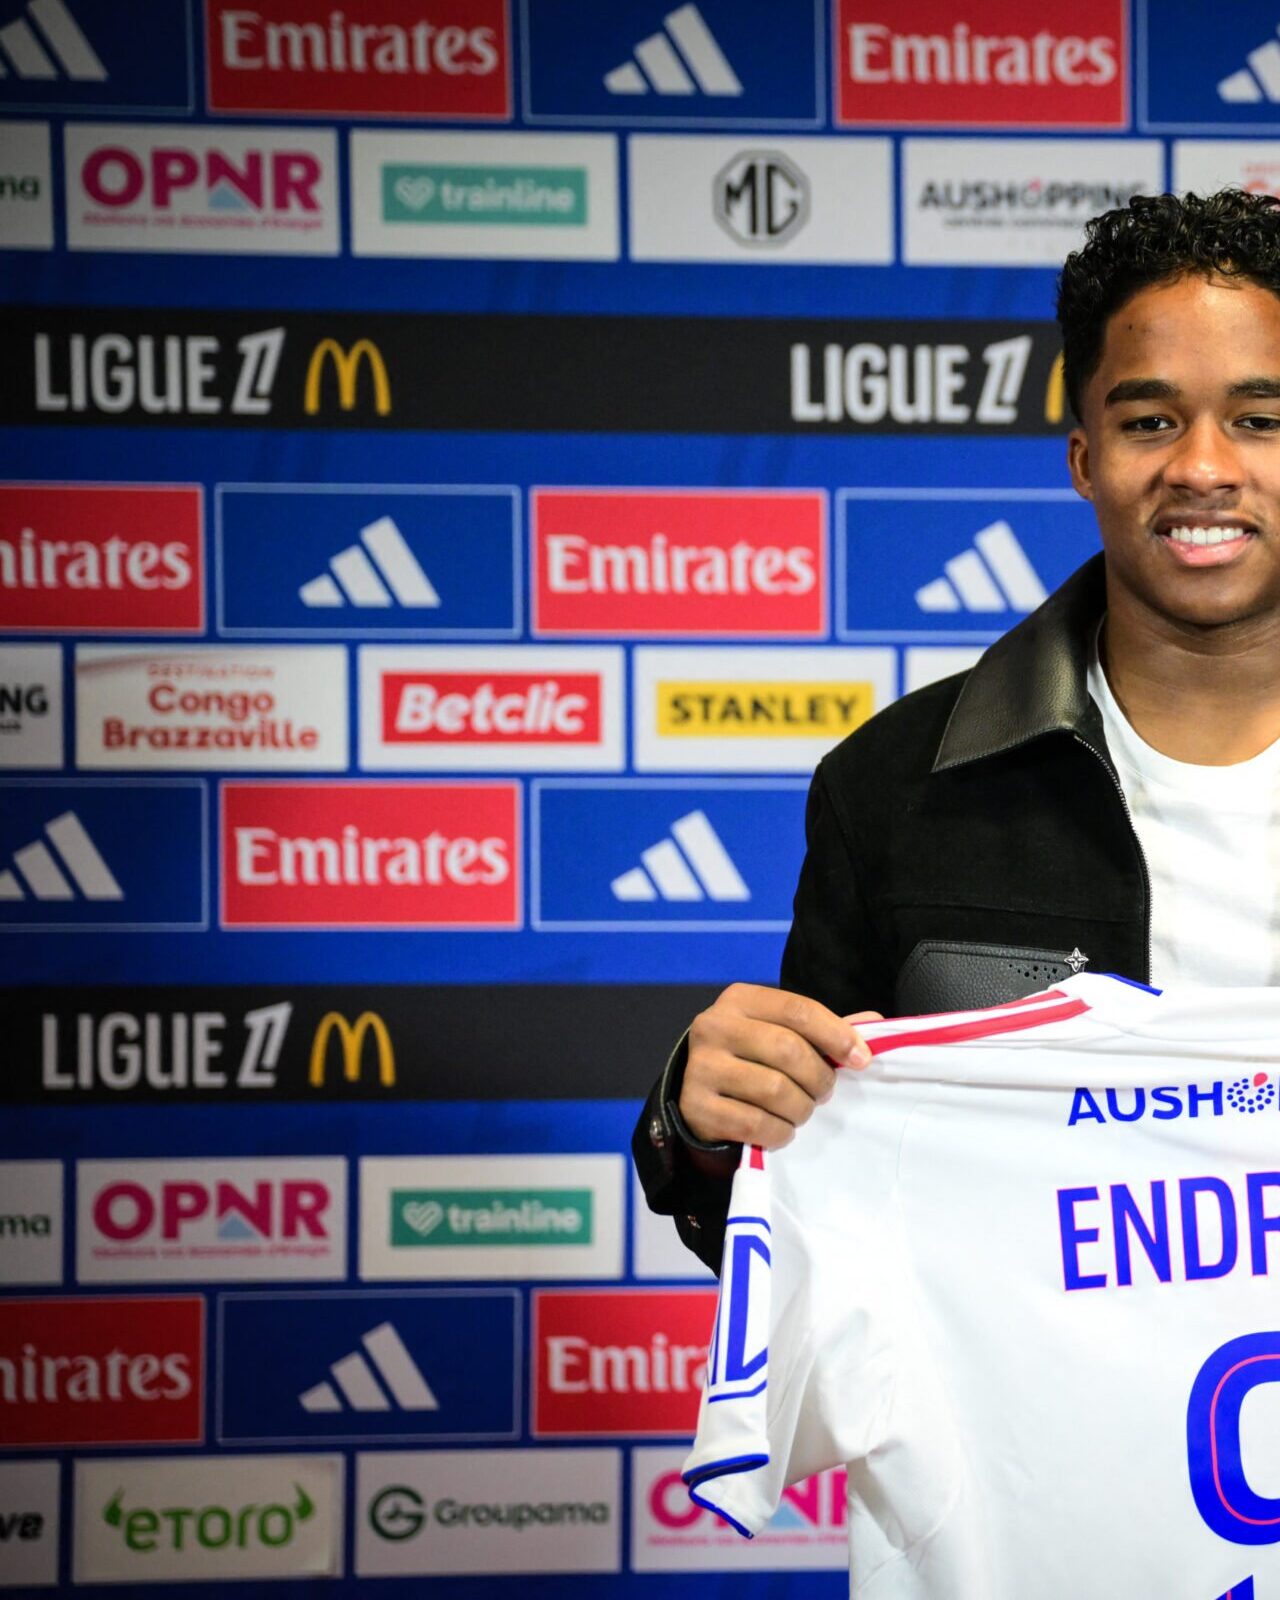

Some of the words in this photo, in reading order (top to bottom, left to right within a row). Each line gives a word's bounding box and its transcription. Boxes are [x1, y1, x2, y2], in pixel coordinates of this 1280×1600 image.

[222, 12, 498, 75] Emirates
[850, 24, 1116, 84] Emirates
[80, 147, 323, 211] OPNR
[441, 179, 575, 213] trainline
[724, 162, 800, 236] MG
[36, 335, 221, 413] LIGUE
[792, 344, 970, 422] LIGUE
[547, 534, 815, 594] Emirates
[148, 683, 276, 720] Congo
[396, 682, 587, 733] Betclic
[670, 695, 858, 724] STANLEY
[102, 717, 318, 750] Brazzaville
[237, 826, 509, 884] Emirates
[44, 1013, 226, 1088] LIGUE
[92, 1180, 330, 1240] OPNR
[448, 1200, 583, 1233] trainline
[432, 1498, 609, 1531] Groupama
